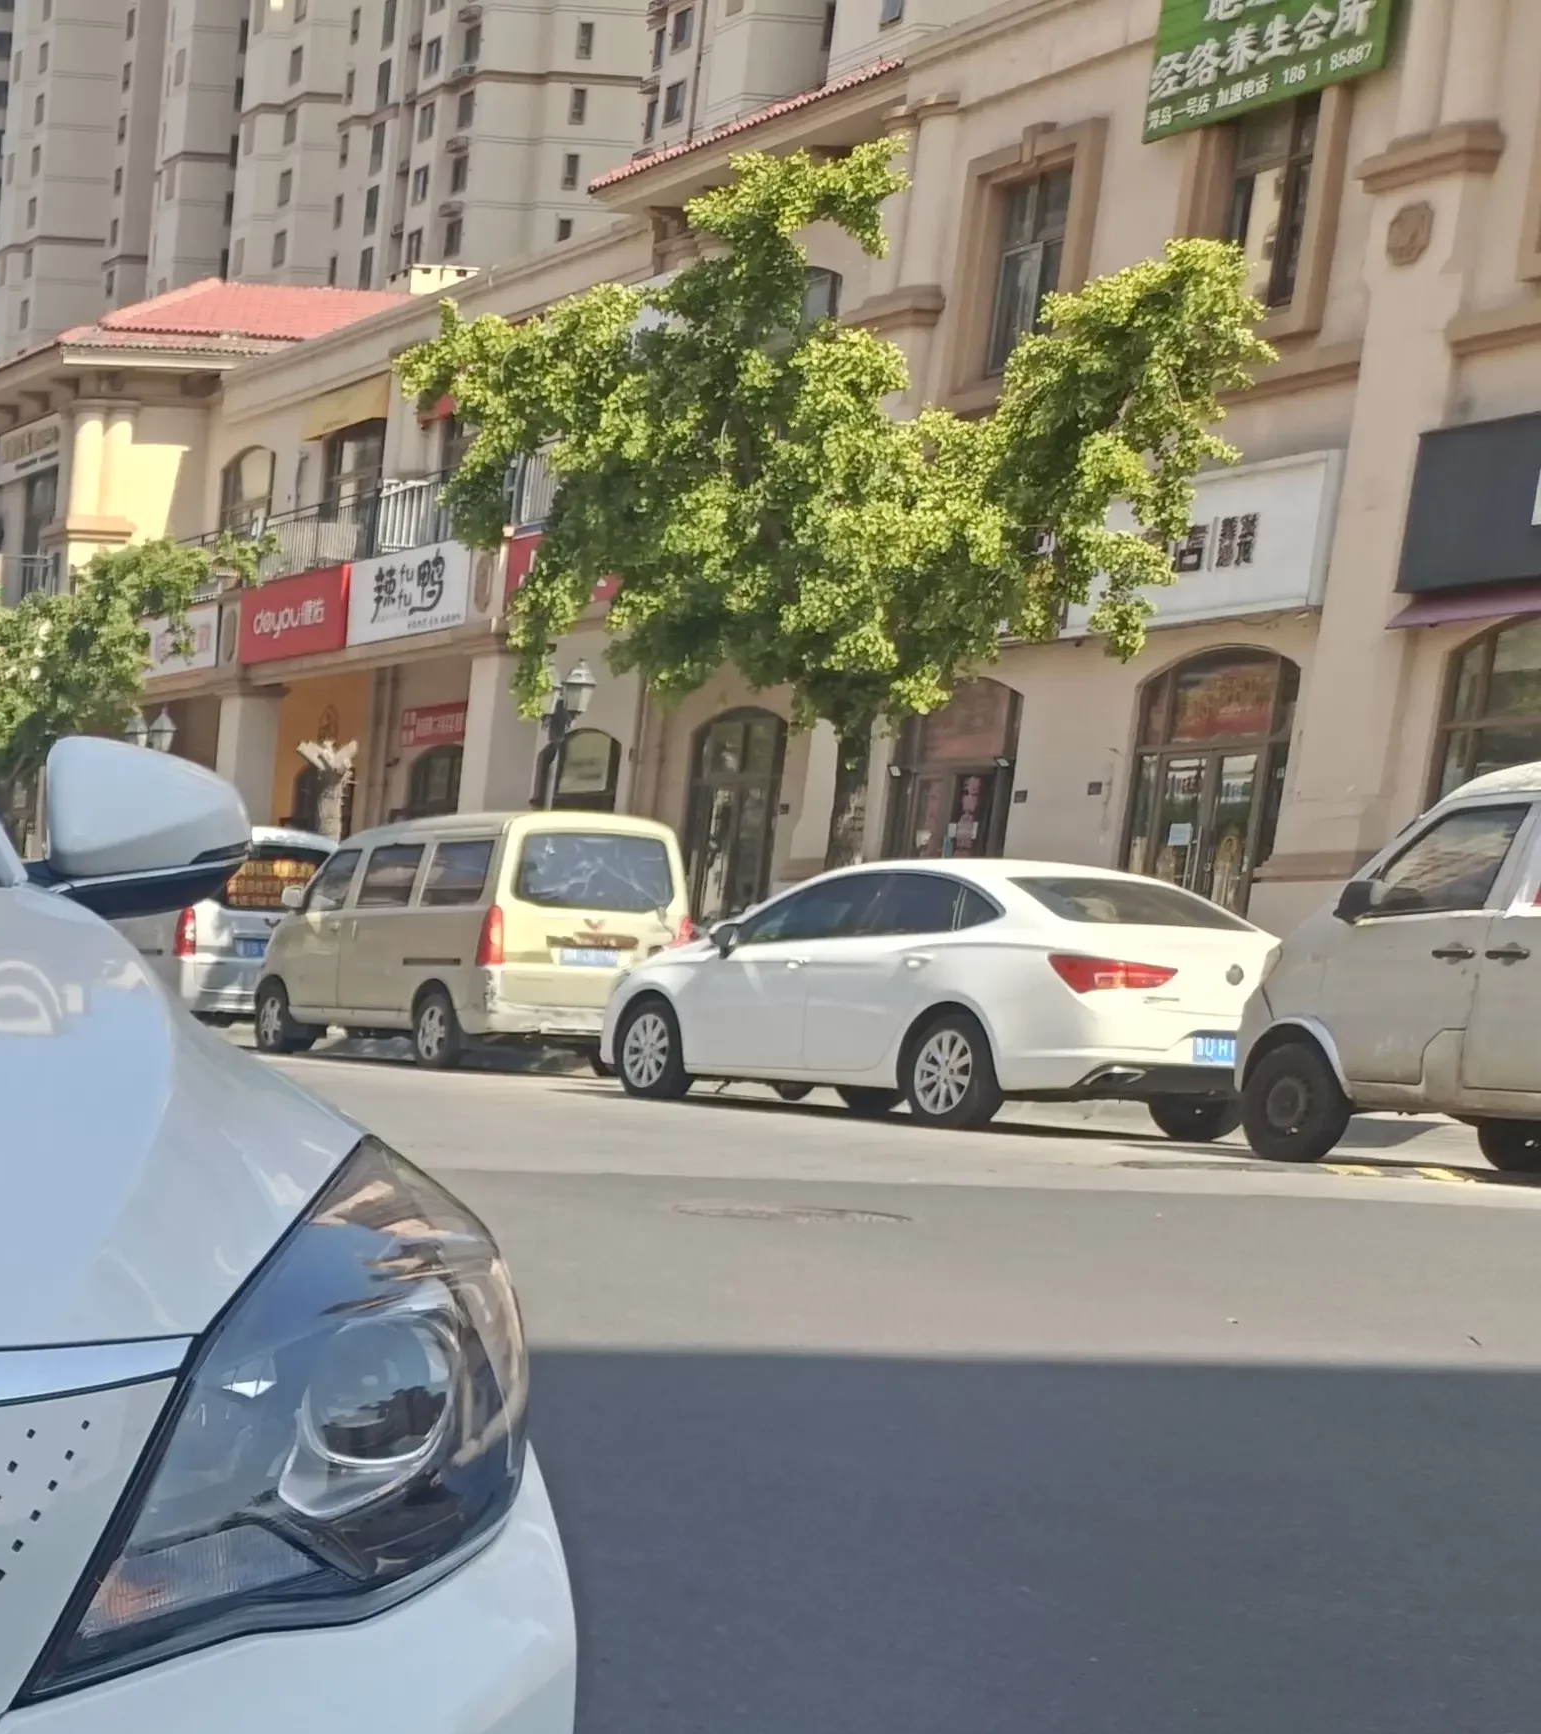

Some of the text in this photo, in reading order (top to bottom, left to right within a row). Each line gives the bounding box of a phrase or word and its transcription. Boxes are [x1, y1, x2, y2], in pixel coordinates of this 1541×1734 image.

[1149, 0, 1374, 101] 经络养生会所
[1148, 92, 1212, 130] 青岛一号店
[1282, 63, 1307, 85] 186
